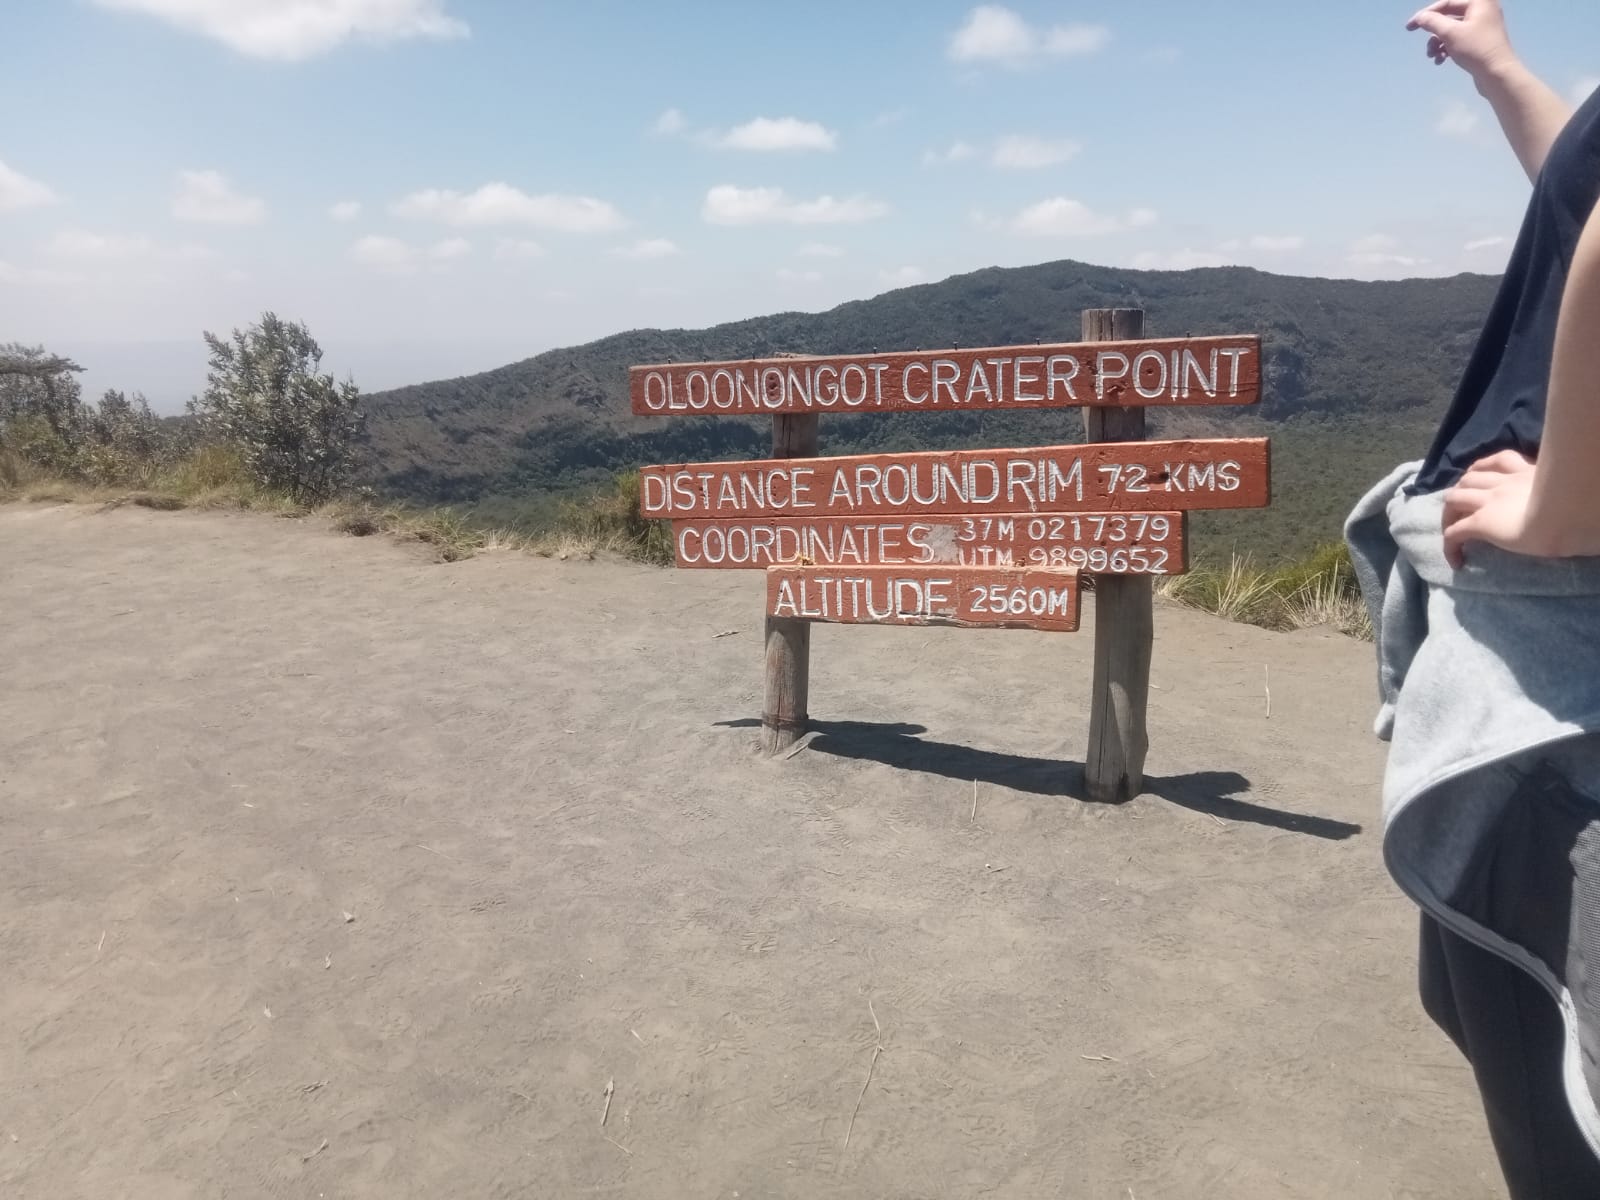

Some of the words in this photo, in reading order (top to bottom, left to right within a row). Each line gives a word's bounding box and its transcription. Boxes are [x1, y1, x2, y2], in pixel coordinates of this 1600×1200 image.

[644, 363, 889, 409] OLOONONGOT
[903, 354, 1079, 403] CRATER
[1095, 348, 1250, 400] POINT
[644, 467, 816, 512] DISTANCE
[828, 460, 999, 509] AROUND
[1006, 458, 1083, 509] RIM
[1164, 460, 1241, 492] KMS
[678, 523, 934, 564] COORDINATES
[959, 518, 1014, 541] 37M
[1028, 515, 1170, 541] 0217379
[1028, 546, 1169, 573] 9899652
[774, 576, 952, 618] ALTITUDE
[969, 585, 1069, 616] 2560M
